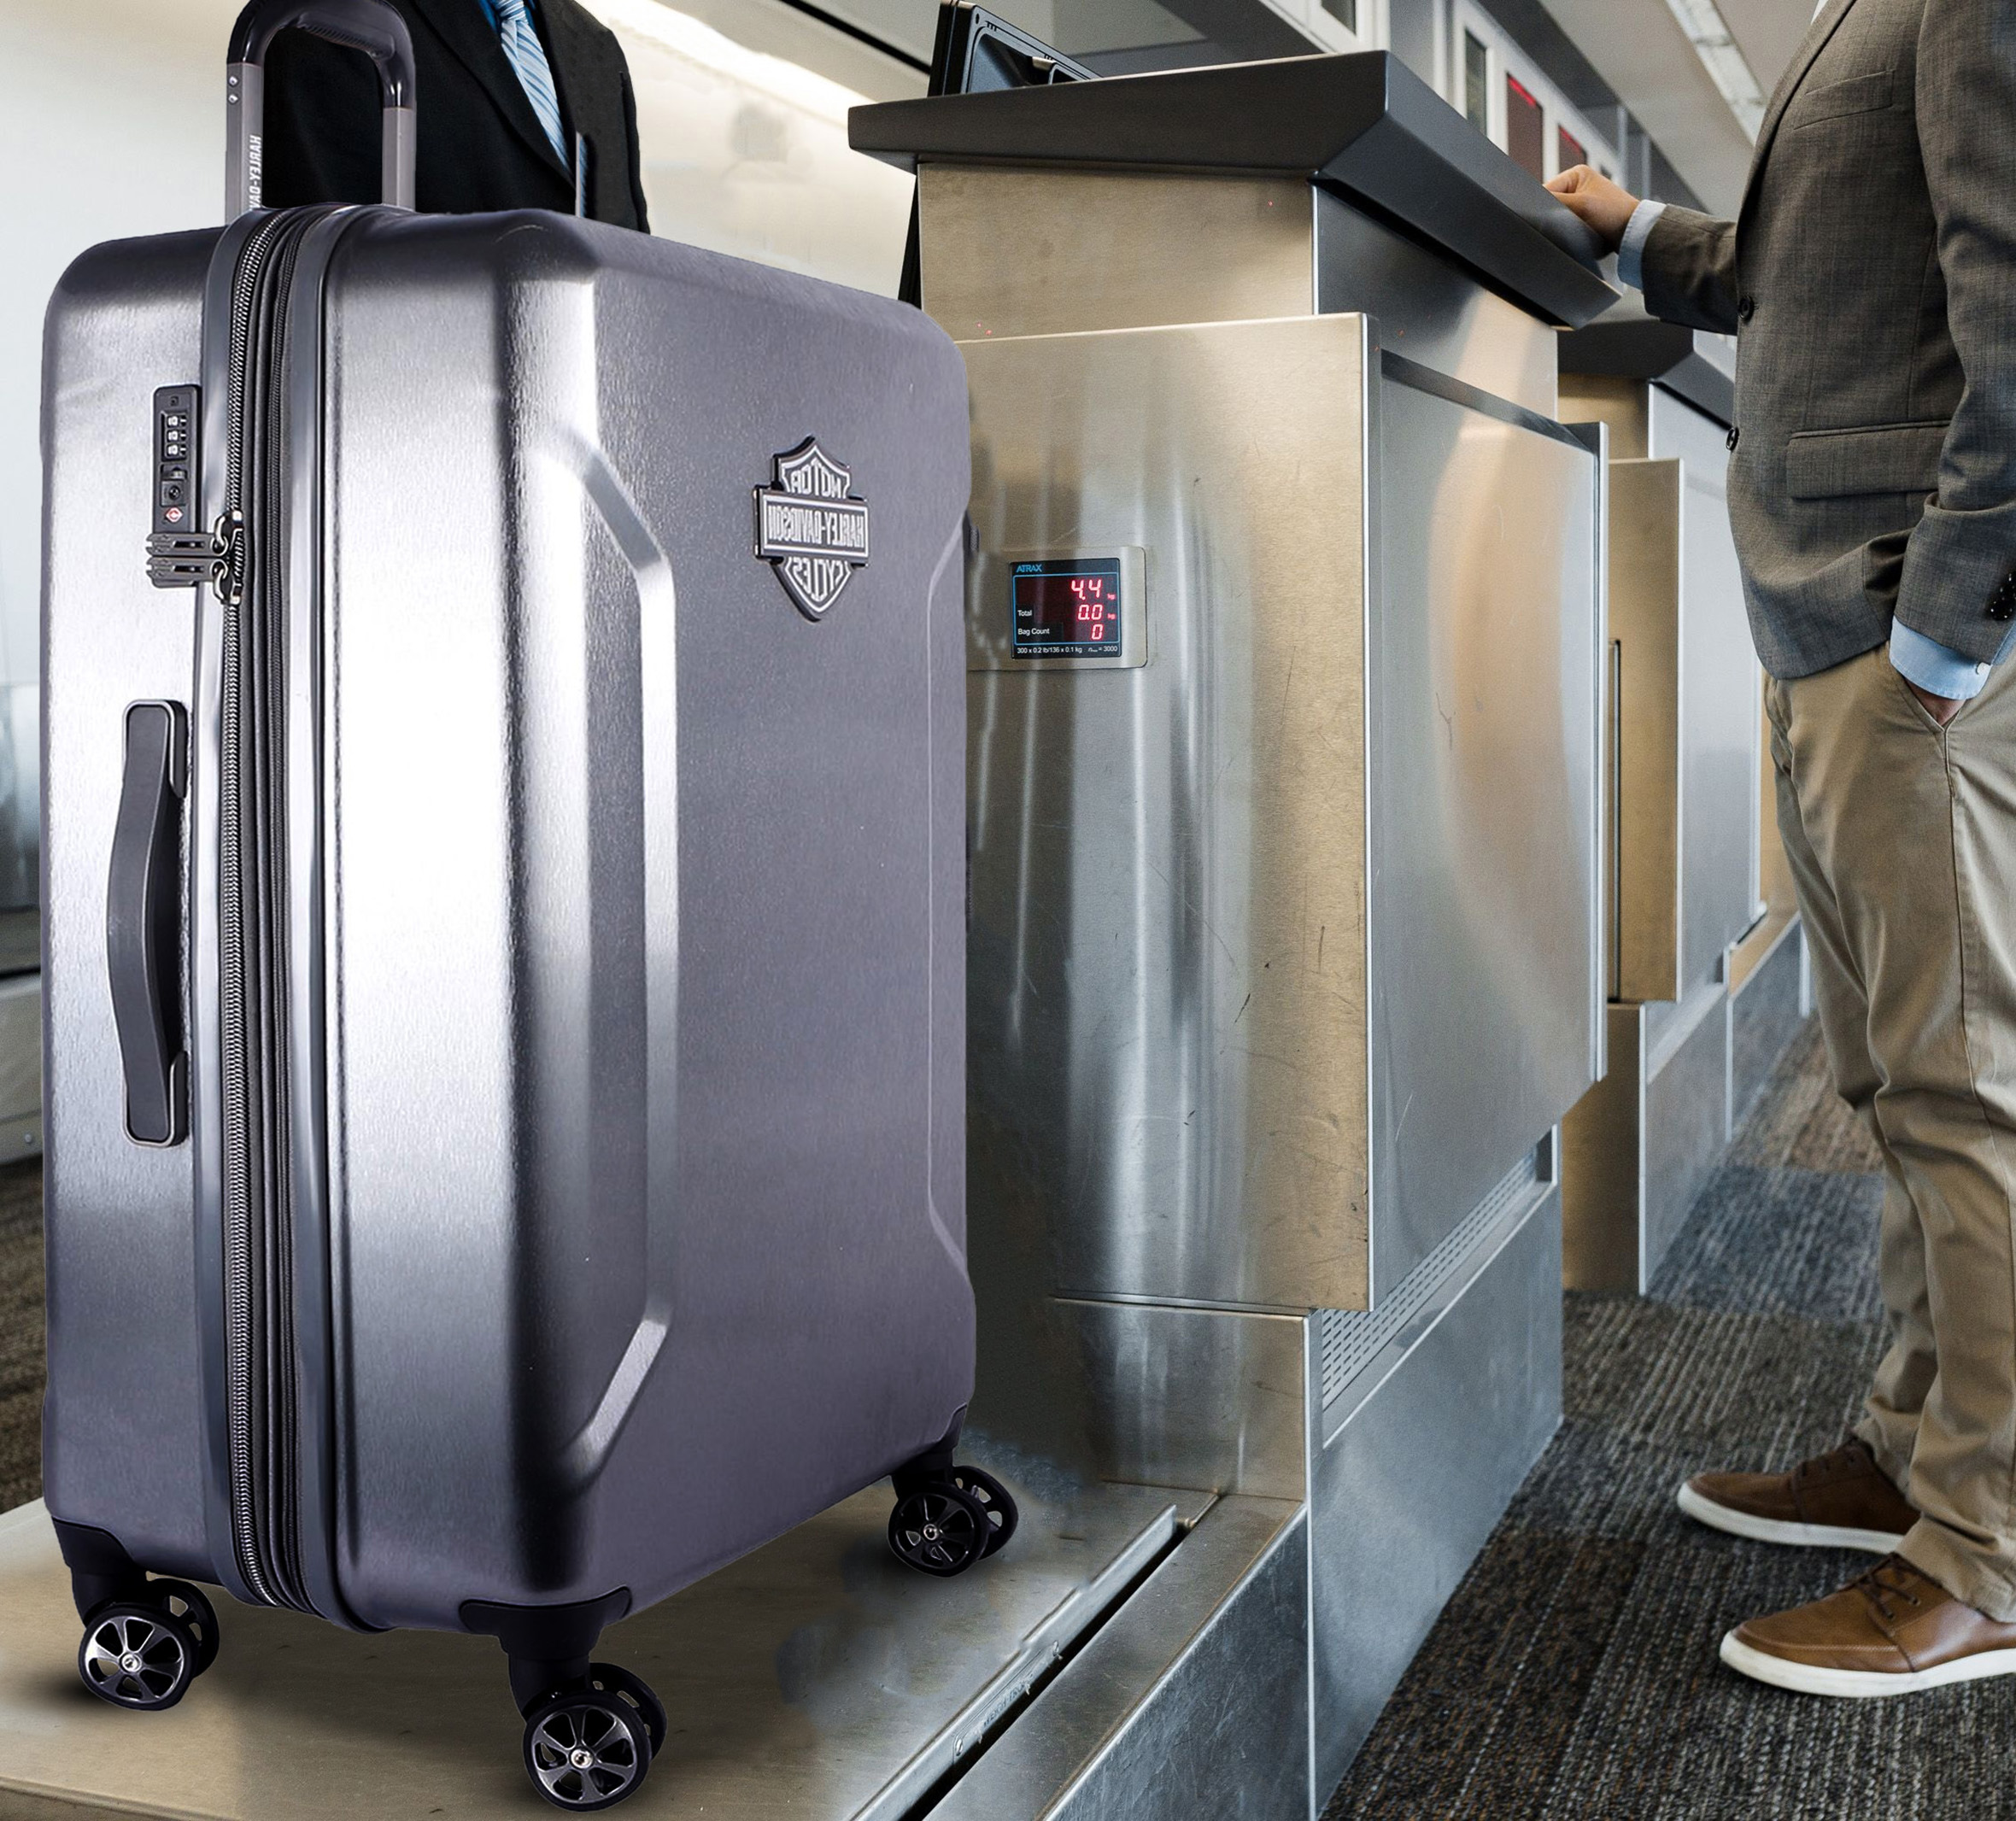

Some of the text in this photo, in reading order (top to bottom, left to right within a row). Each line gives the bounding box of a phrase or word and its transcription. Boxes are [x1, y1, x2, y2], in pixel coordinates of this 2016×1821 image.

[1016, 564, 1042, 573] ATRAX
[1071, 579, 1102, 600] 4.4
[1077, 604, 1104, 621] 0.0
[1017, 628, 1031, 636] Bag
[1091, 624, 1104, 641] 0
